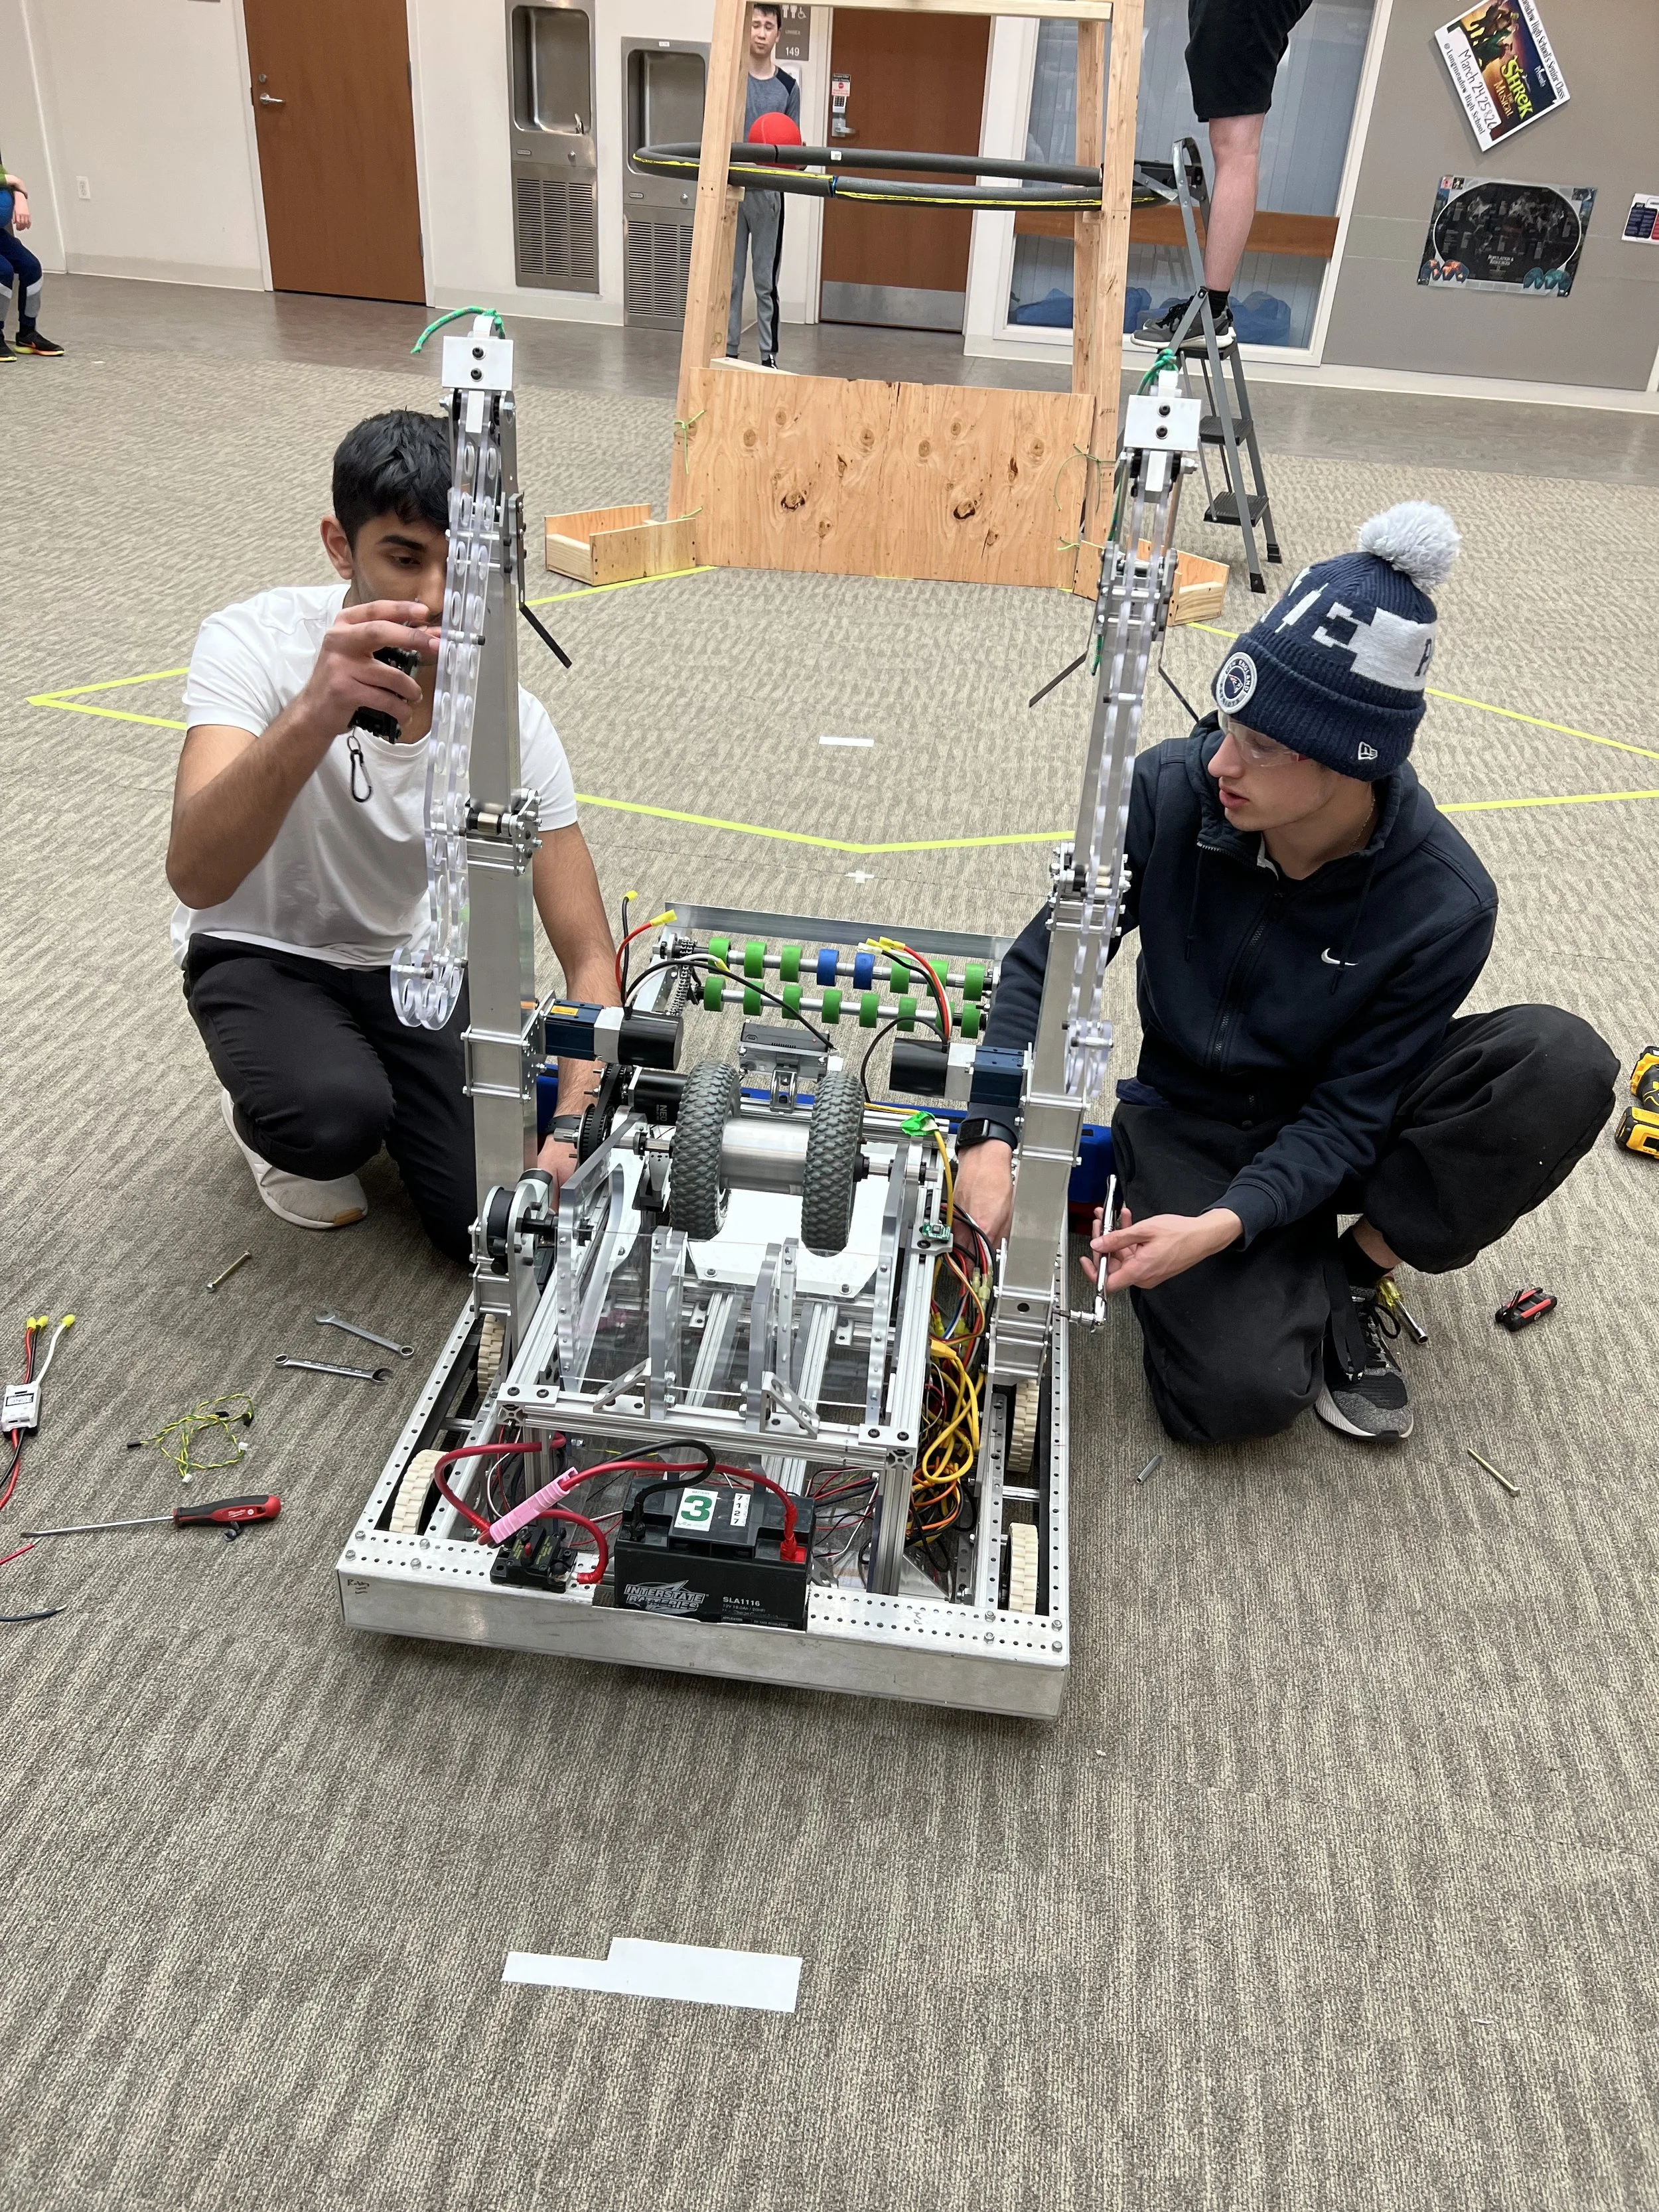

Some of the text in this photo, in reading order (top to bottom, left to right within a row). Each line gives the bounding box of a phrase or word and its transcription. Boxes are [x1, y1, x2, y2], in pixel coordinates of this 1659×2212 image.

[785, 46, 800, 56] 149
[1531, 20, 1543, 38] High
[1537, 36, 1553, 63] School's
[1547, 61, 1559, 82] Senior
[1555, 81, 1565, 100] Class
[1458, 48, 1479, 84] March
[1465, 94, 1475, 111] High
[1473, 111, 1486, 135] School
[1238, 660, 1251, 692] ENGLAND
[681, 1495, 713, 1522] 3
[626, 1585, 704, 1603] INTERSTATE
[629, 1594, 699, 1610] BATTERIES
[723, 1596, 760, 1607] SLA1116
